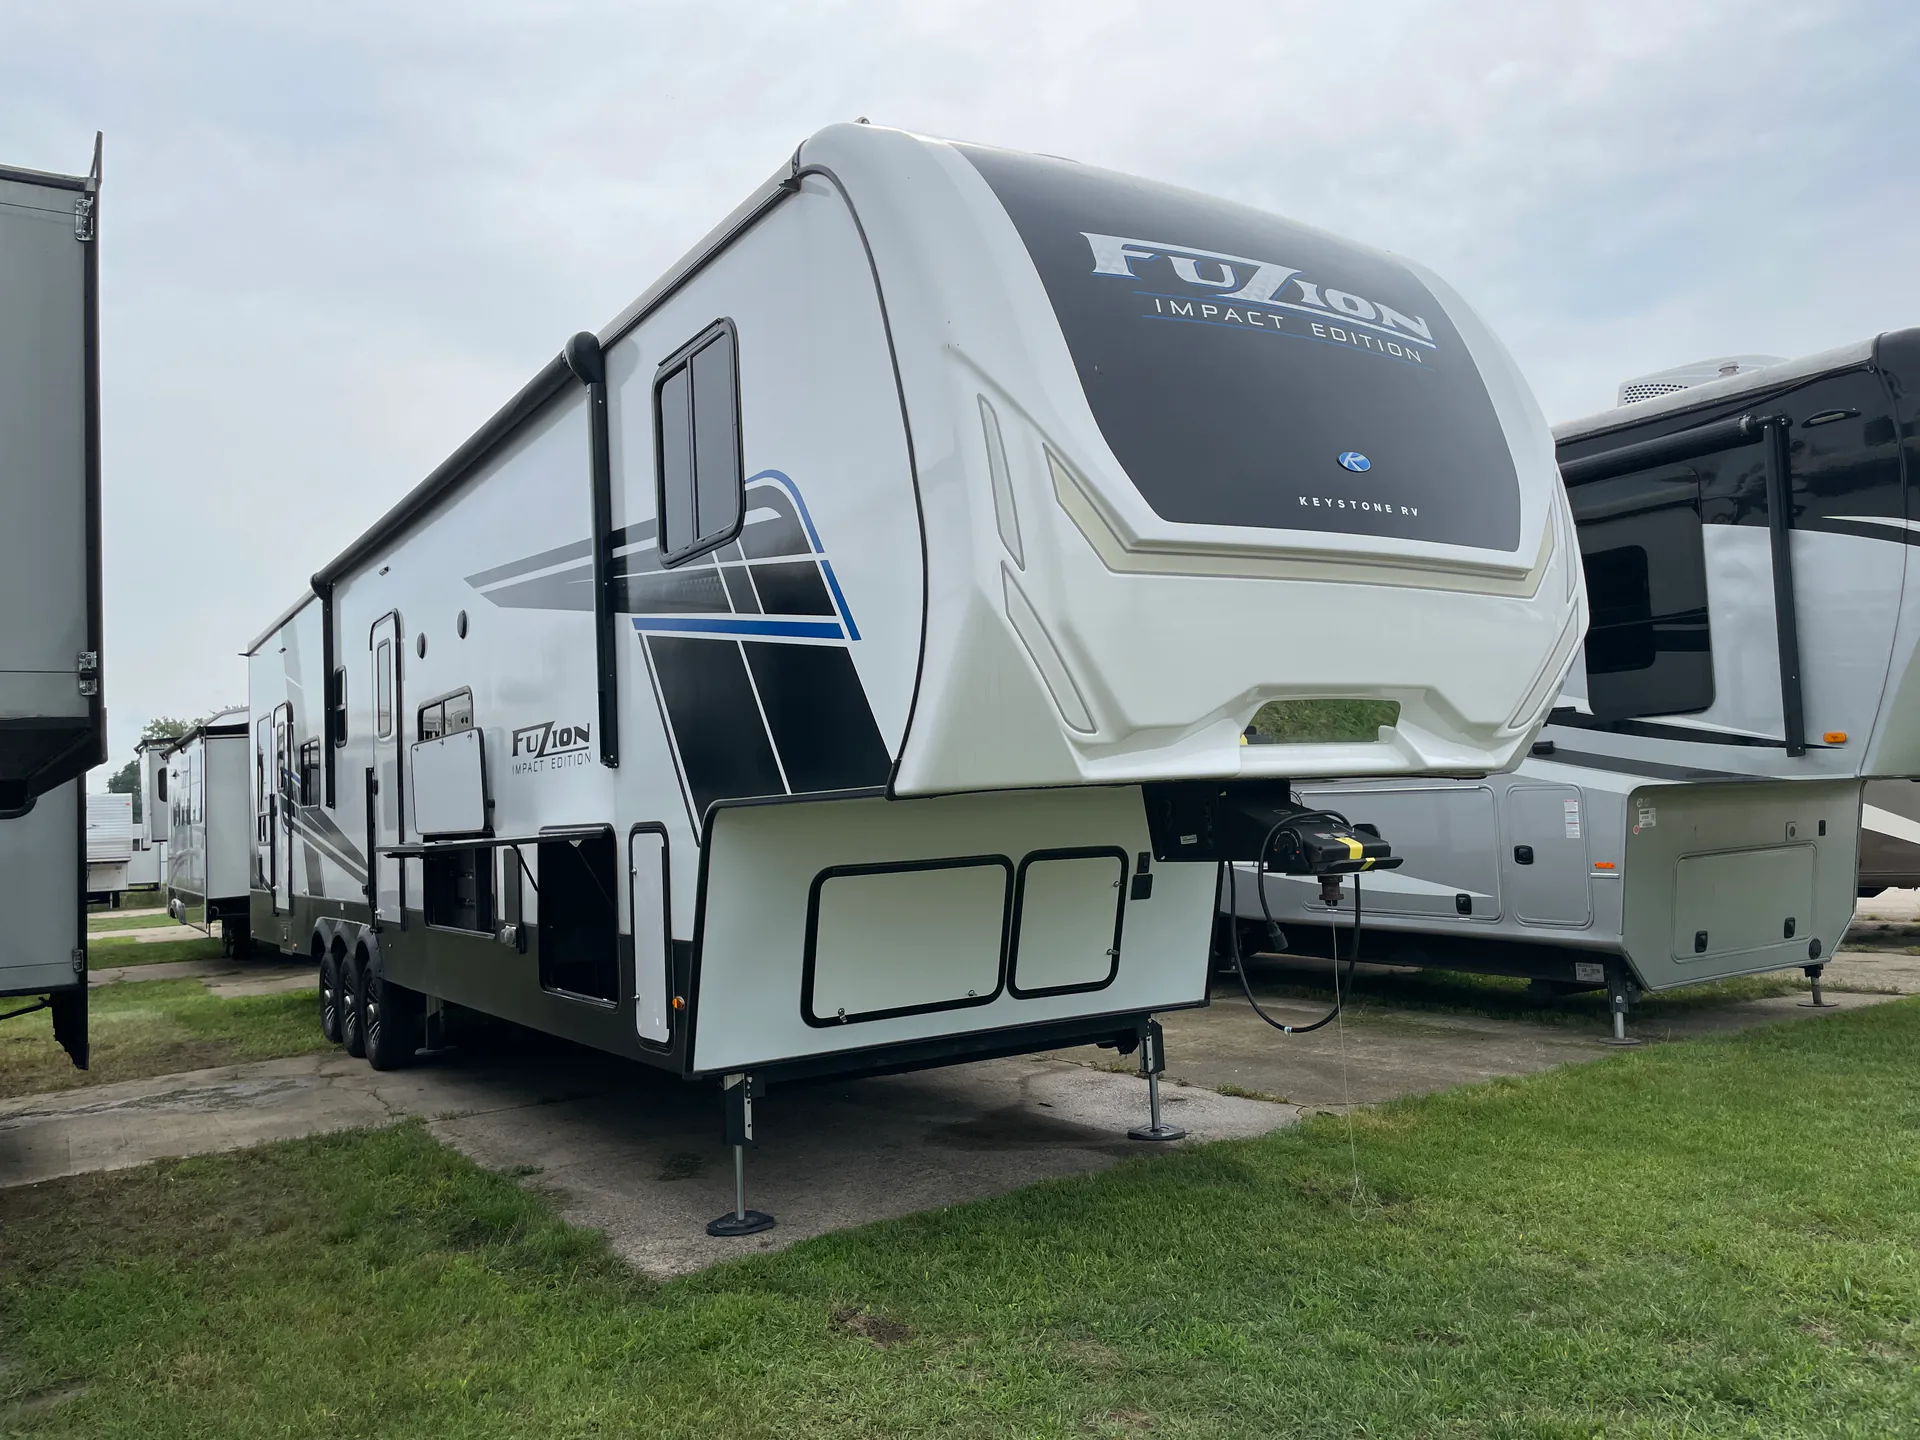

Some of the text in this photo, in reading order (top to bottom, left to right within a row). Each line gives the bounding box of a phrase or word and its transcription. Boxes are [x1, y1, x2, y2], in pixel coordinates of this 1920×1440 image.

[1079, 232, 1437, 349] FUZION
[1155, 298, 1422, 363] IMPACT EDITION
[1299, 496, 1418, 517] KEYSTONE RV
[512, 720, 590, 759] FUZION
[512, 752, 592, 776] IMPACT EDITION
